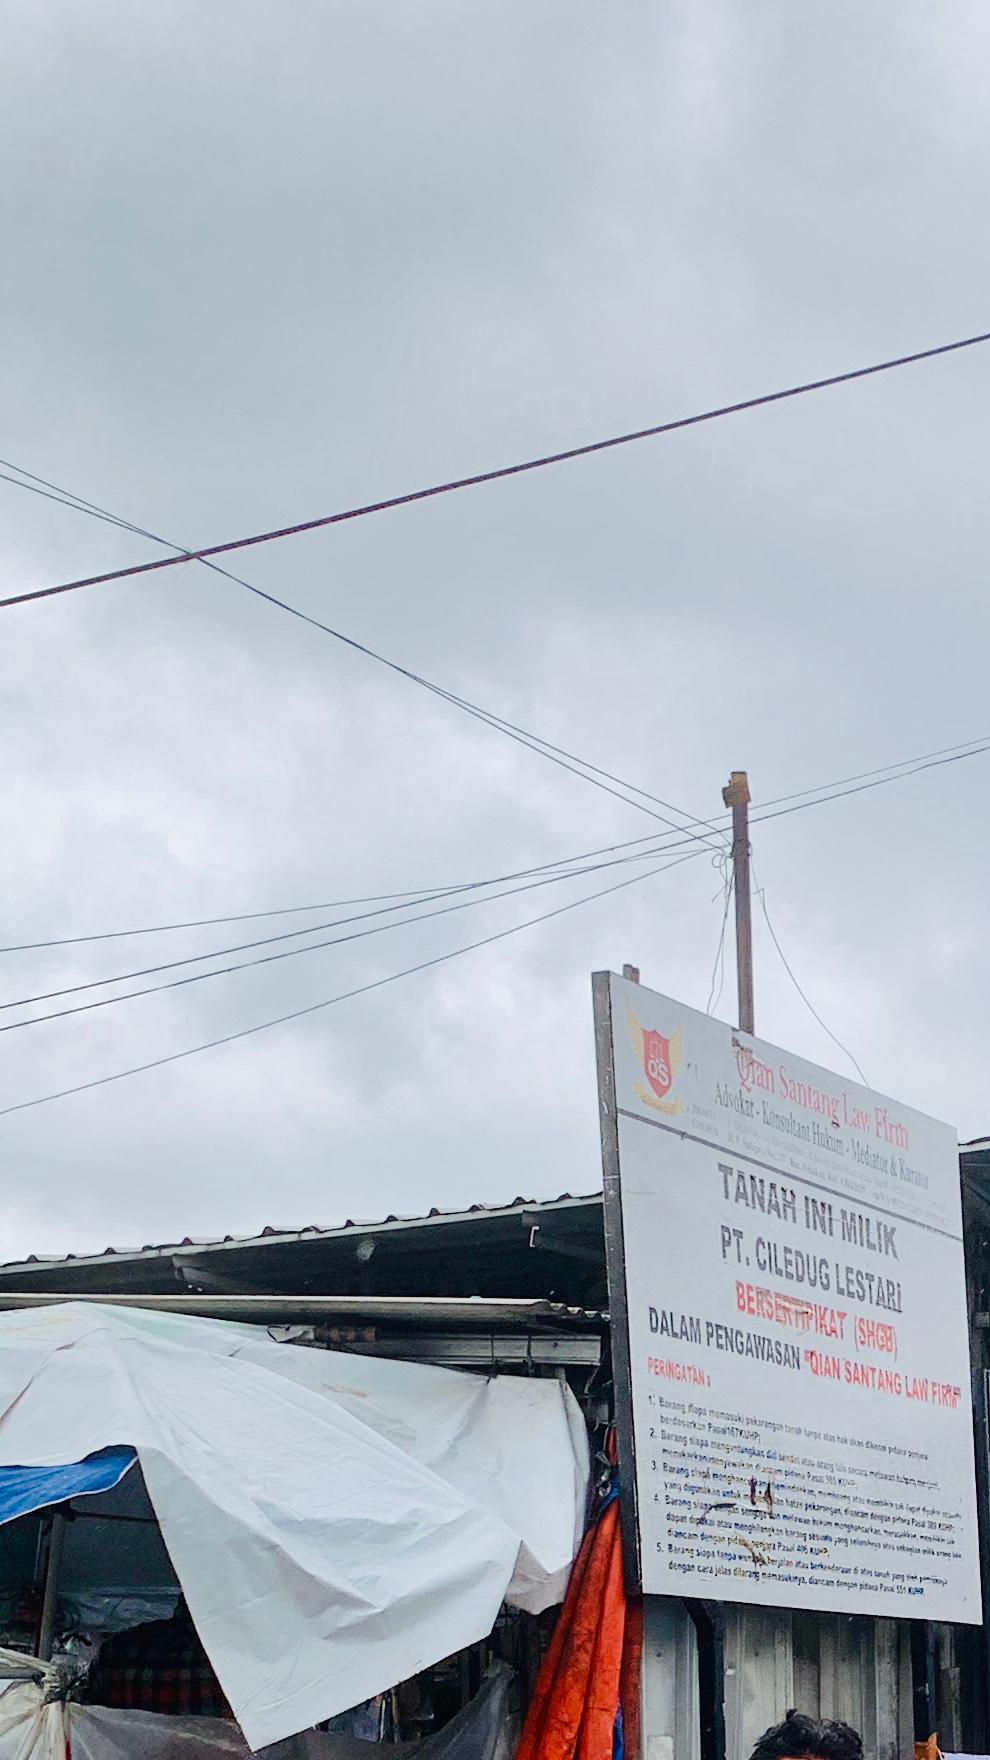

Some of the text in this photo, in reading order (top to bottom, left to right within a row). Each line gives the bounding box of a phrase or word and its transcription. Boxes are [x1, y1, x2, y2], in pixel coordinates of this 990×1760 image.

[716, 1081, 754, 1118] Advokat
[812, 1120, 844, 1156] Hukum
[851, 1137, 888, 1174] Mediator
[780, 1066, 840, 1128] Santang
[842, 1092, 871, 1133] Law
[875, 1105, 909, 1150] Firm
[718, 1164, 797, 1224] TANAH
[804, 1196, 834, 1236] INI
[840, 1208, 900, 1262] MILIK
[720, 1225, 902, 1312] PT. CILEDUG LESTARI
[648, 1306, 702, 1344] DALAM
[706, 1321, 800, 1370] PENGAWASAN
[844, 1360, 901, 1394] SANTANG
[905, 1376, 928, 1401] LAW
[648, 1357, 704, 1385] PERINGATAN
